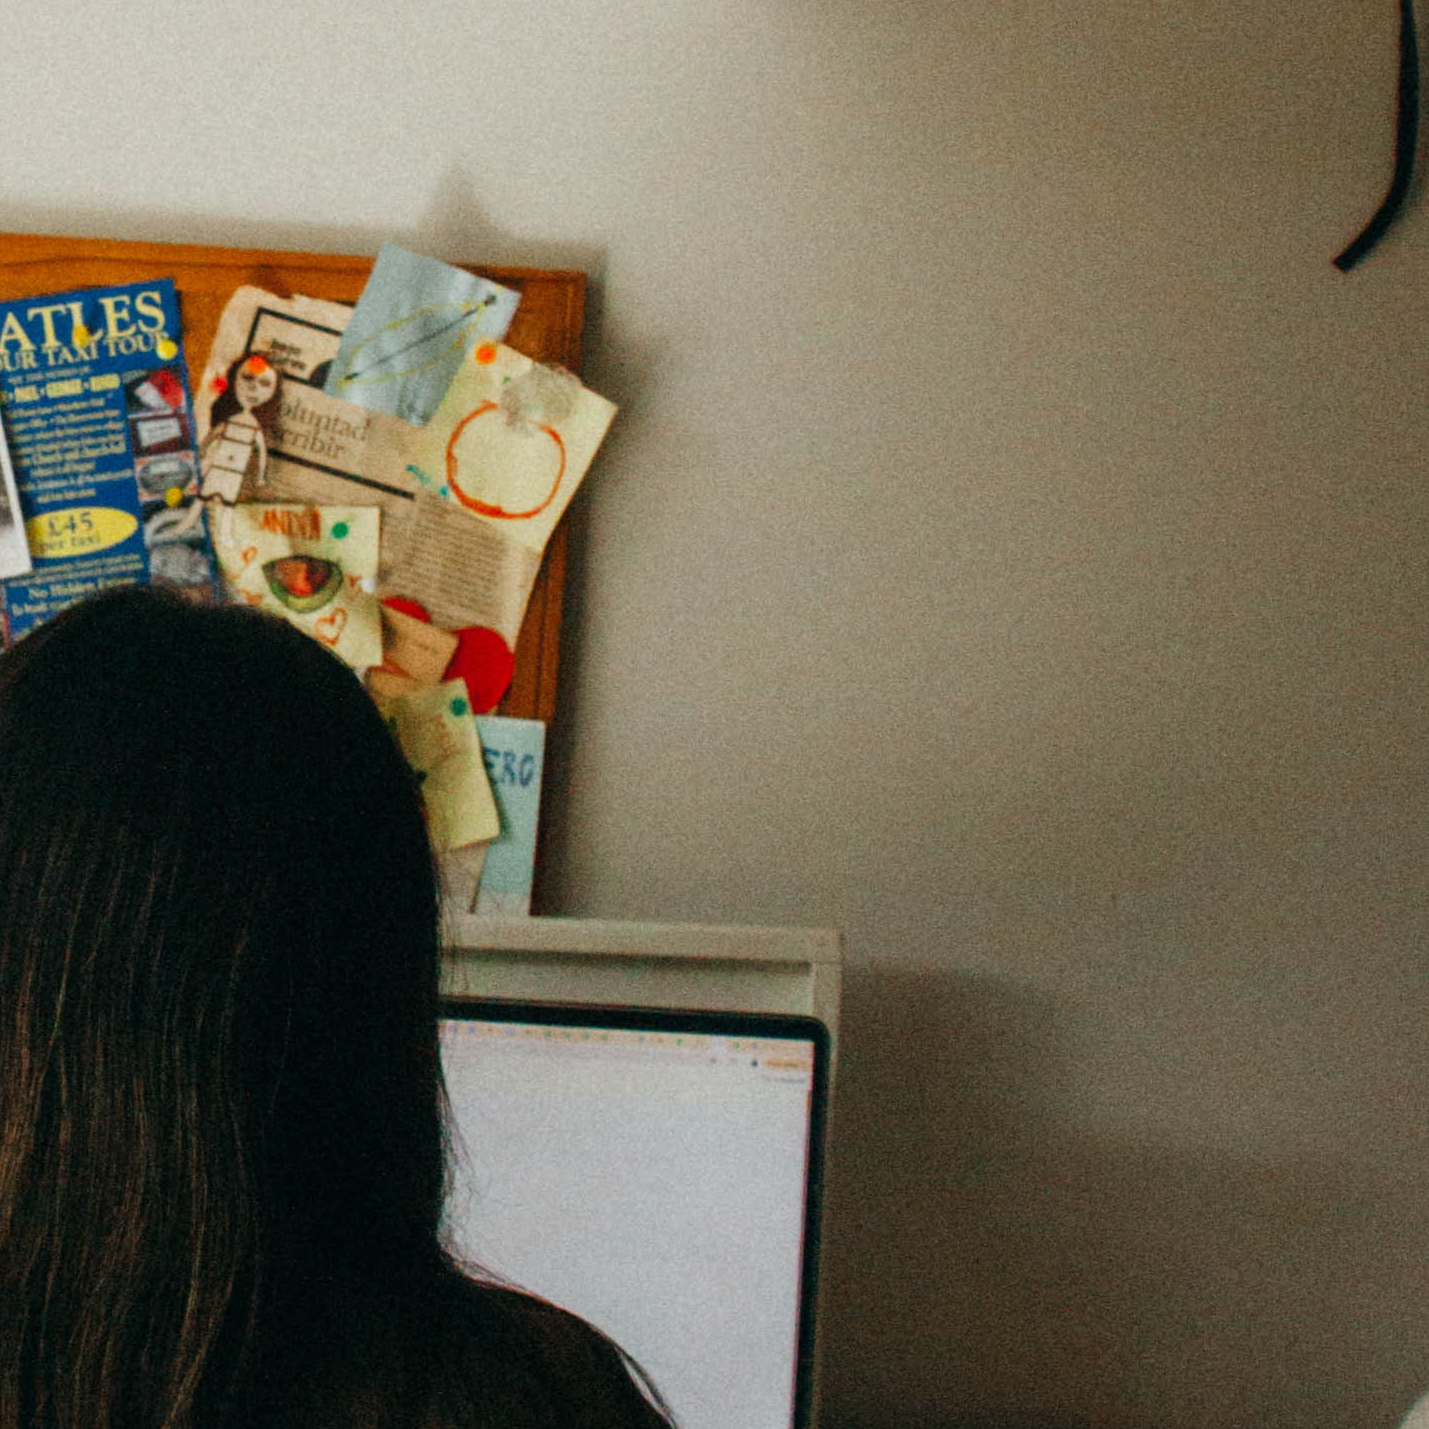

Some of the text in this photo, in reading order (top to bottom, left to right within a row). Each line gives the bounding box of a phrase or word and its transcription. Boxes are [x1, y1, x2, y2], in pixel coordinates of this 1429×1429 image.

[42, 340, 100, 368] TAXI
[274, 396, 371, 442] oluntad
[47, 511, 95, 537] £45
